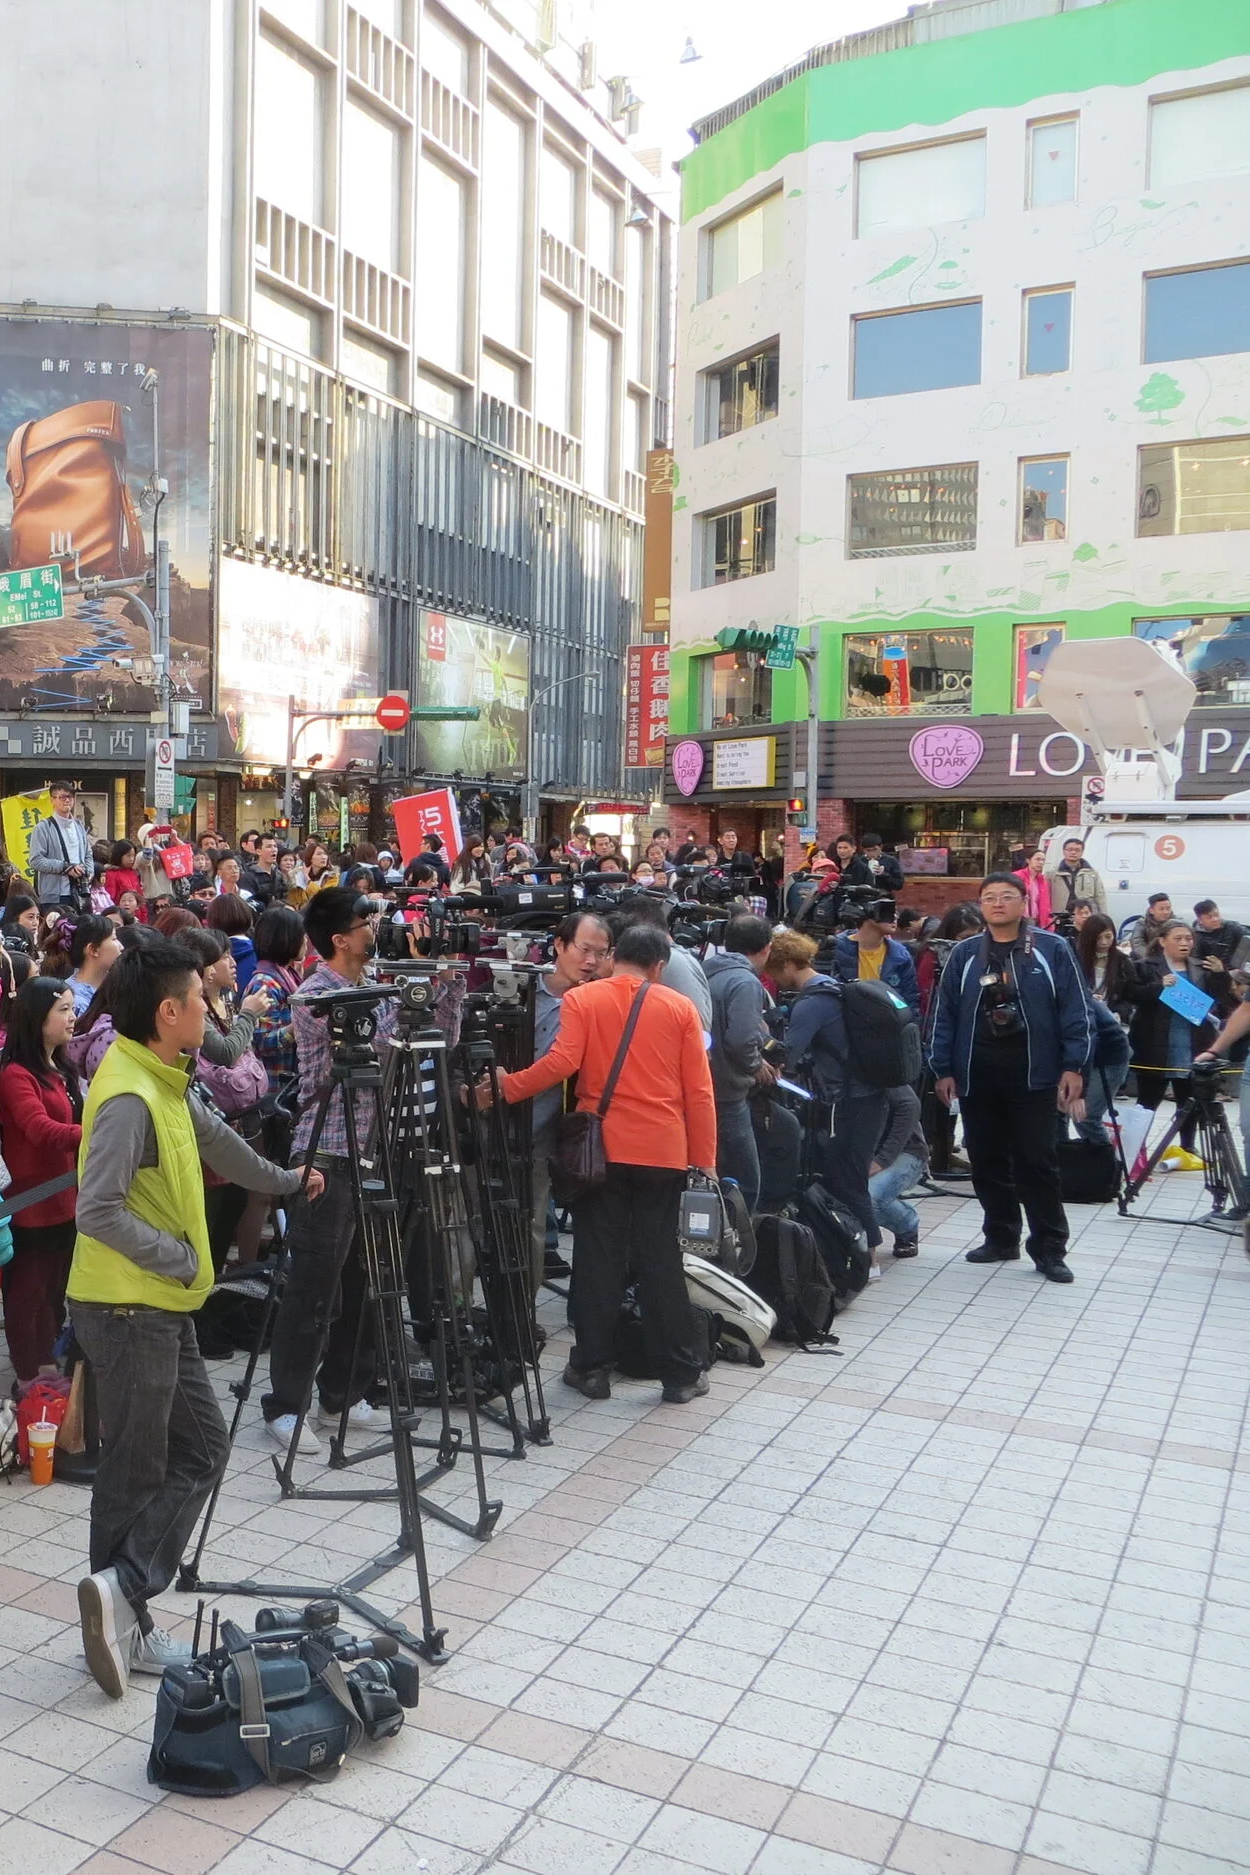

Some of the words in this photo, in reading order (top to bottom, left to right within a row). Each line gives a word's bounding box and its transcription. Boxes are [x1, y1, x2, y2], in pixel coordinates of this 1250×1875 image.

[84, 359, 147, 376] 完整了我
[1162, 839, 1176, 855] 5
